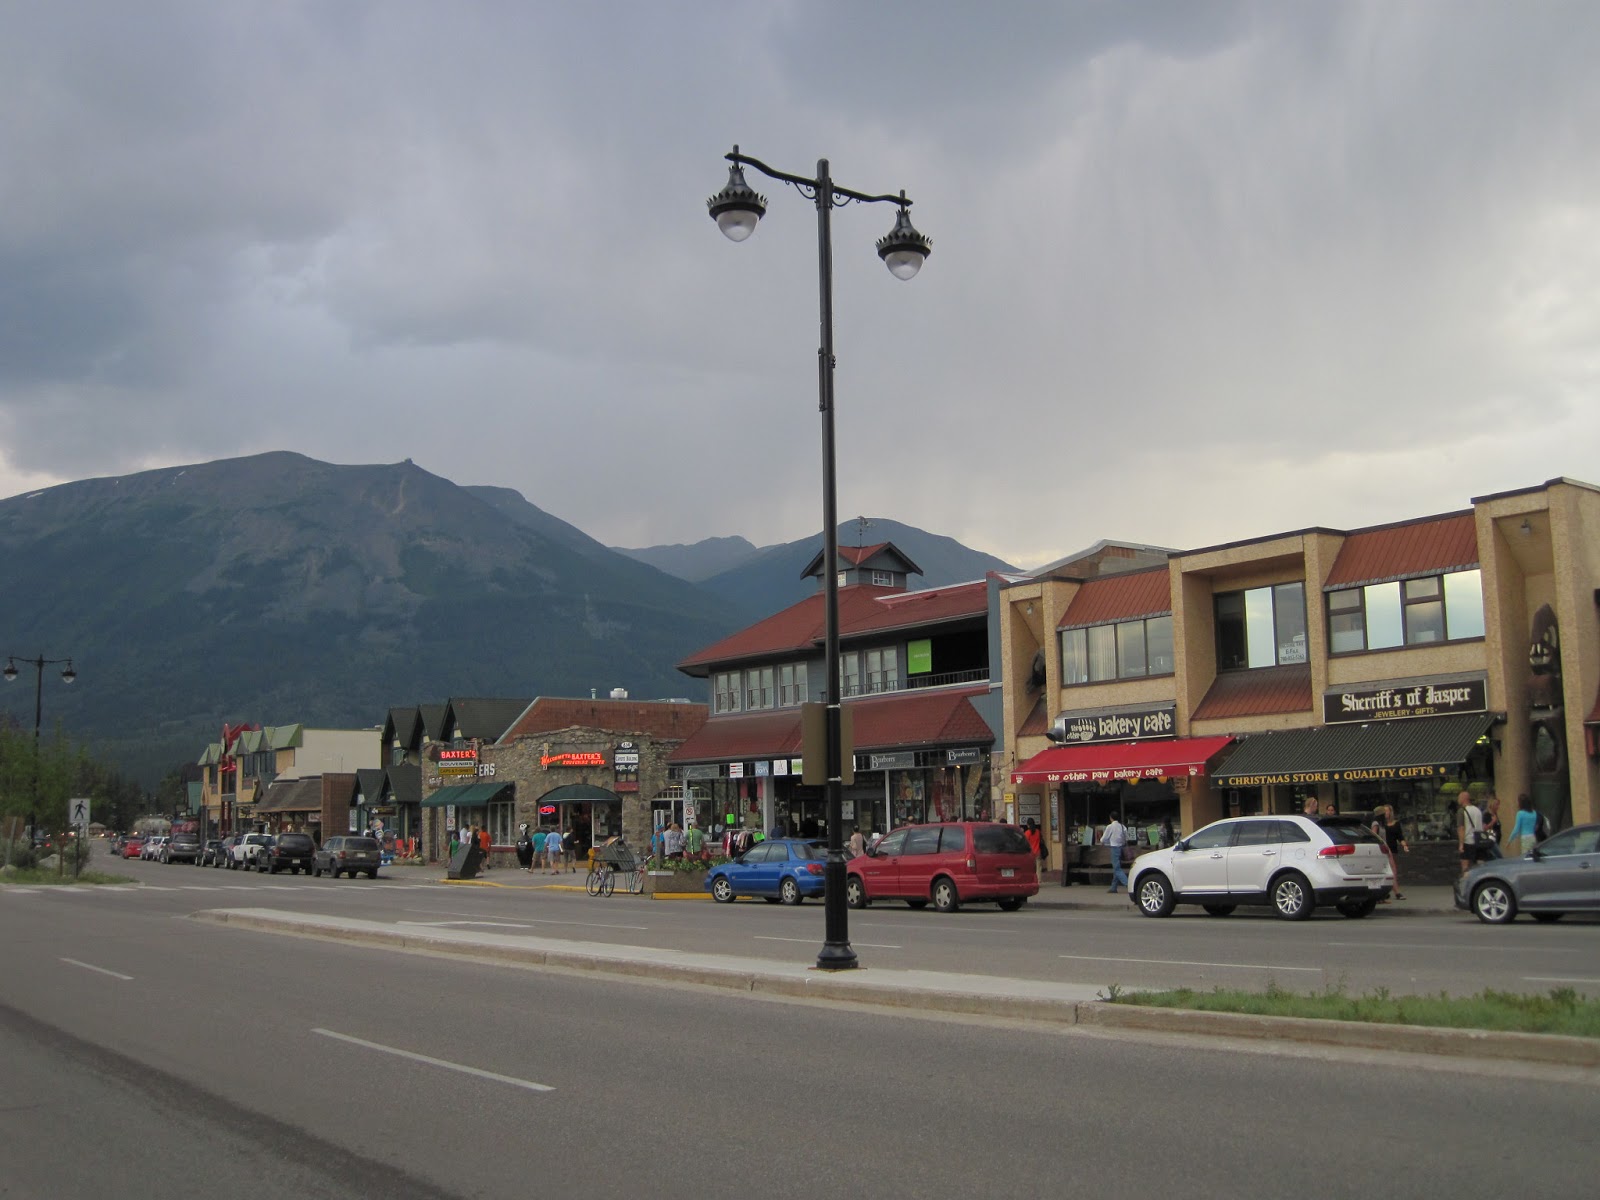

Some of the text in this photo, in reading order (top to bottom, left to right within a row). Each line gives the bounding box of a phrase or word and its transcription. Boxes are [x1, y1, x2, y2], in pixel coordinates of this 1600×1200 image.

[1406, 687, 1423, 706] of
[1425, 685, 1471, 708] Jasper
[1373, 706, 1435, 719] JEWELERY GIFTS
[1098, 711, 1172, 737] bakery cafe
[441, 750, 476, 759] BAXTER'S
[571, 752, 601, 760] BAXTER'S
[1047, 767, 1163, 781] the other paw bakery cafe
[1228, 766, 1433, 786] CHRISTMAS STORE QUALITY GIFTS
